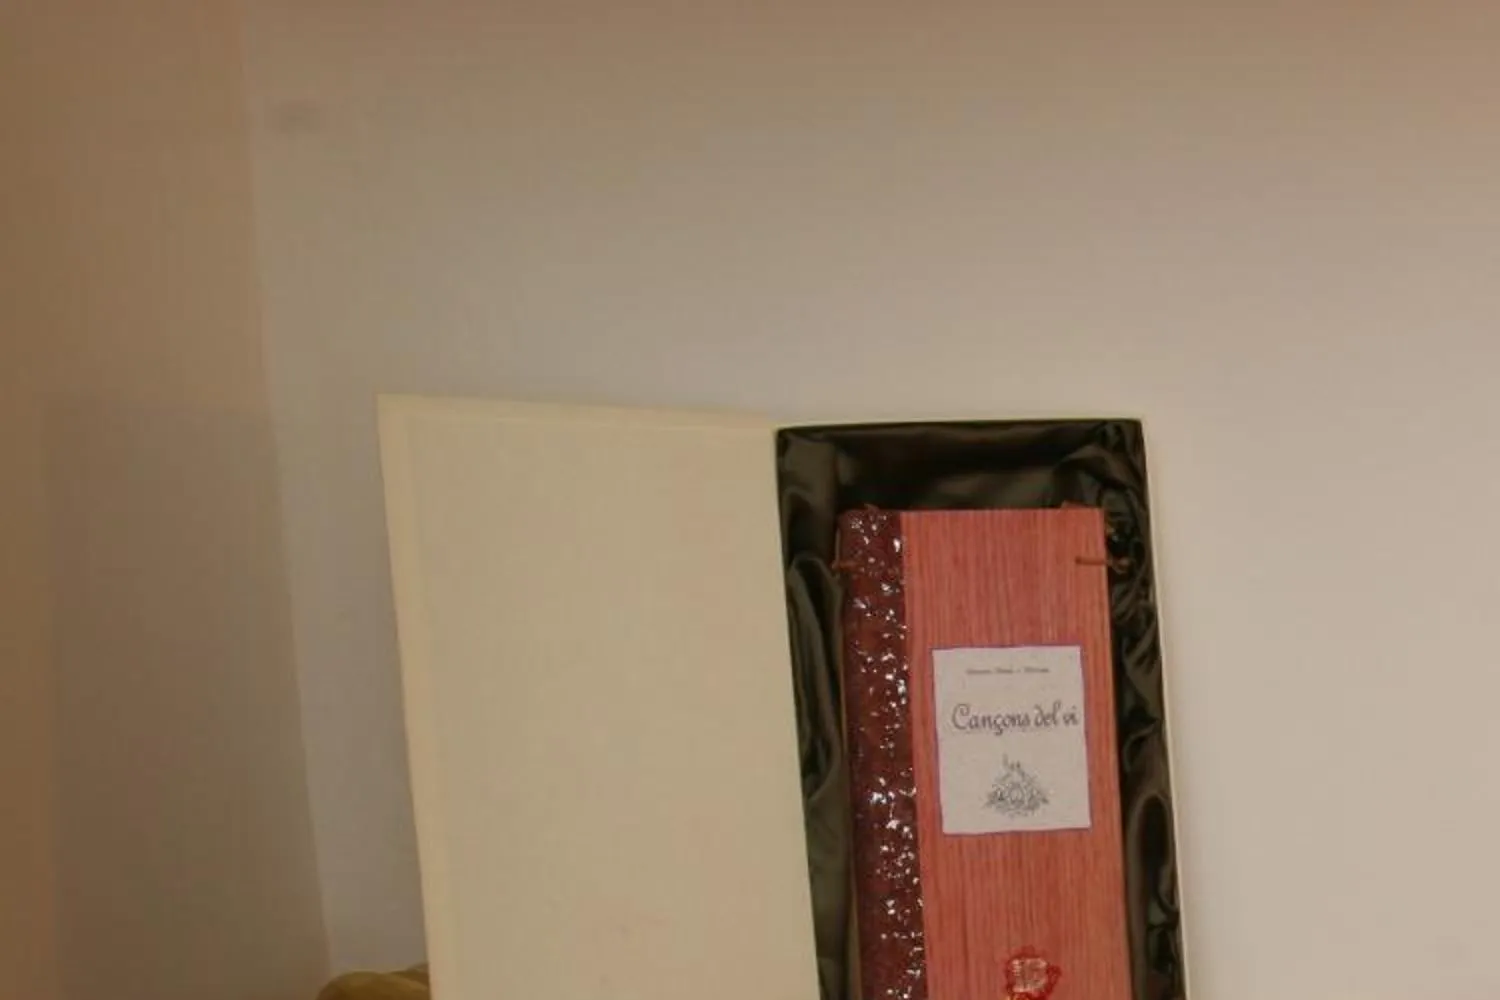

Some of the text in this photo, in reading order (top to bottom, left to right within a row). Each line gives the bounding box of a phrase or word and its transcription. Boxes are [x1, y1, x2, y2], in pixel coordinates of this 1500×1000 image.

[952, 699, 1080, 736] Cançons del vi
